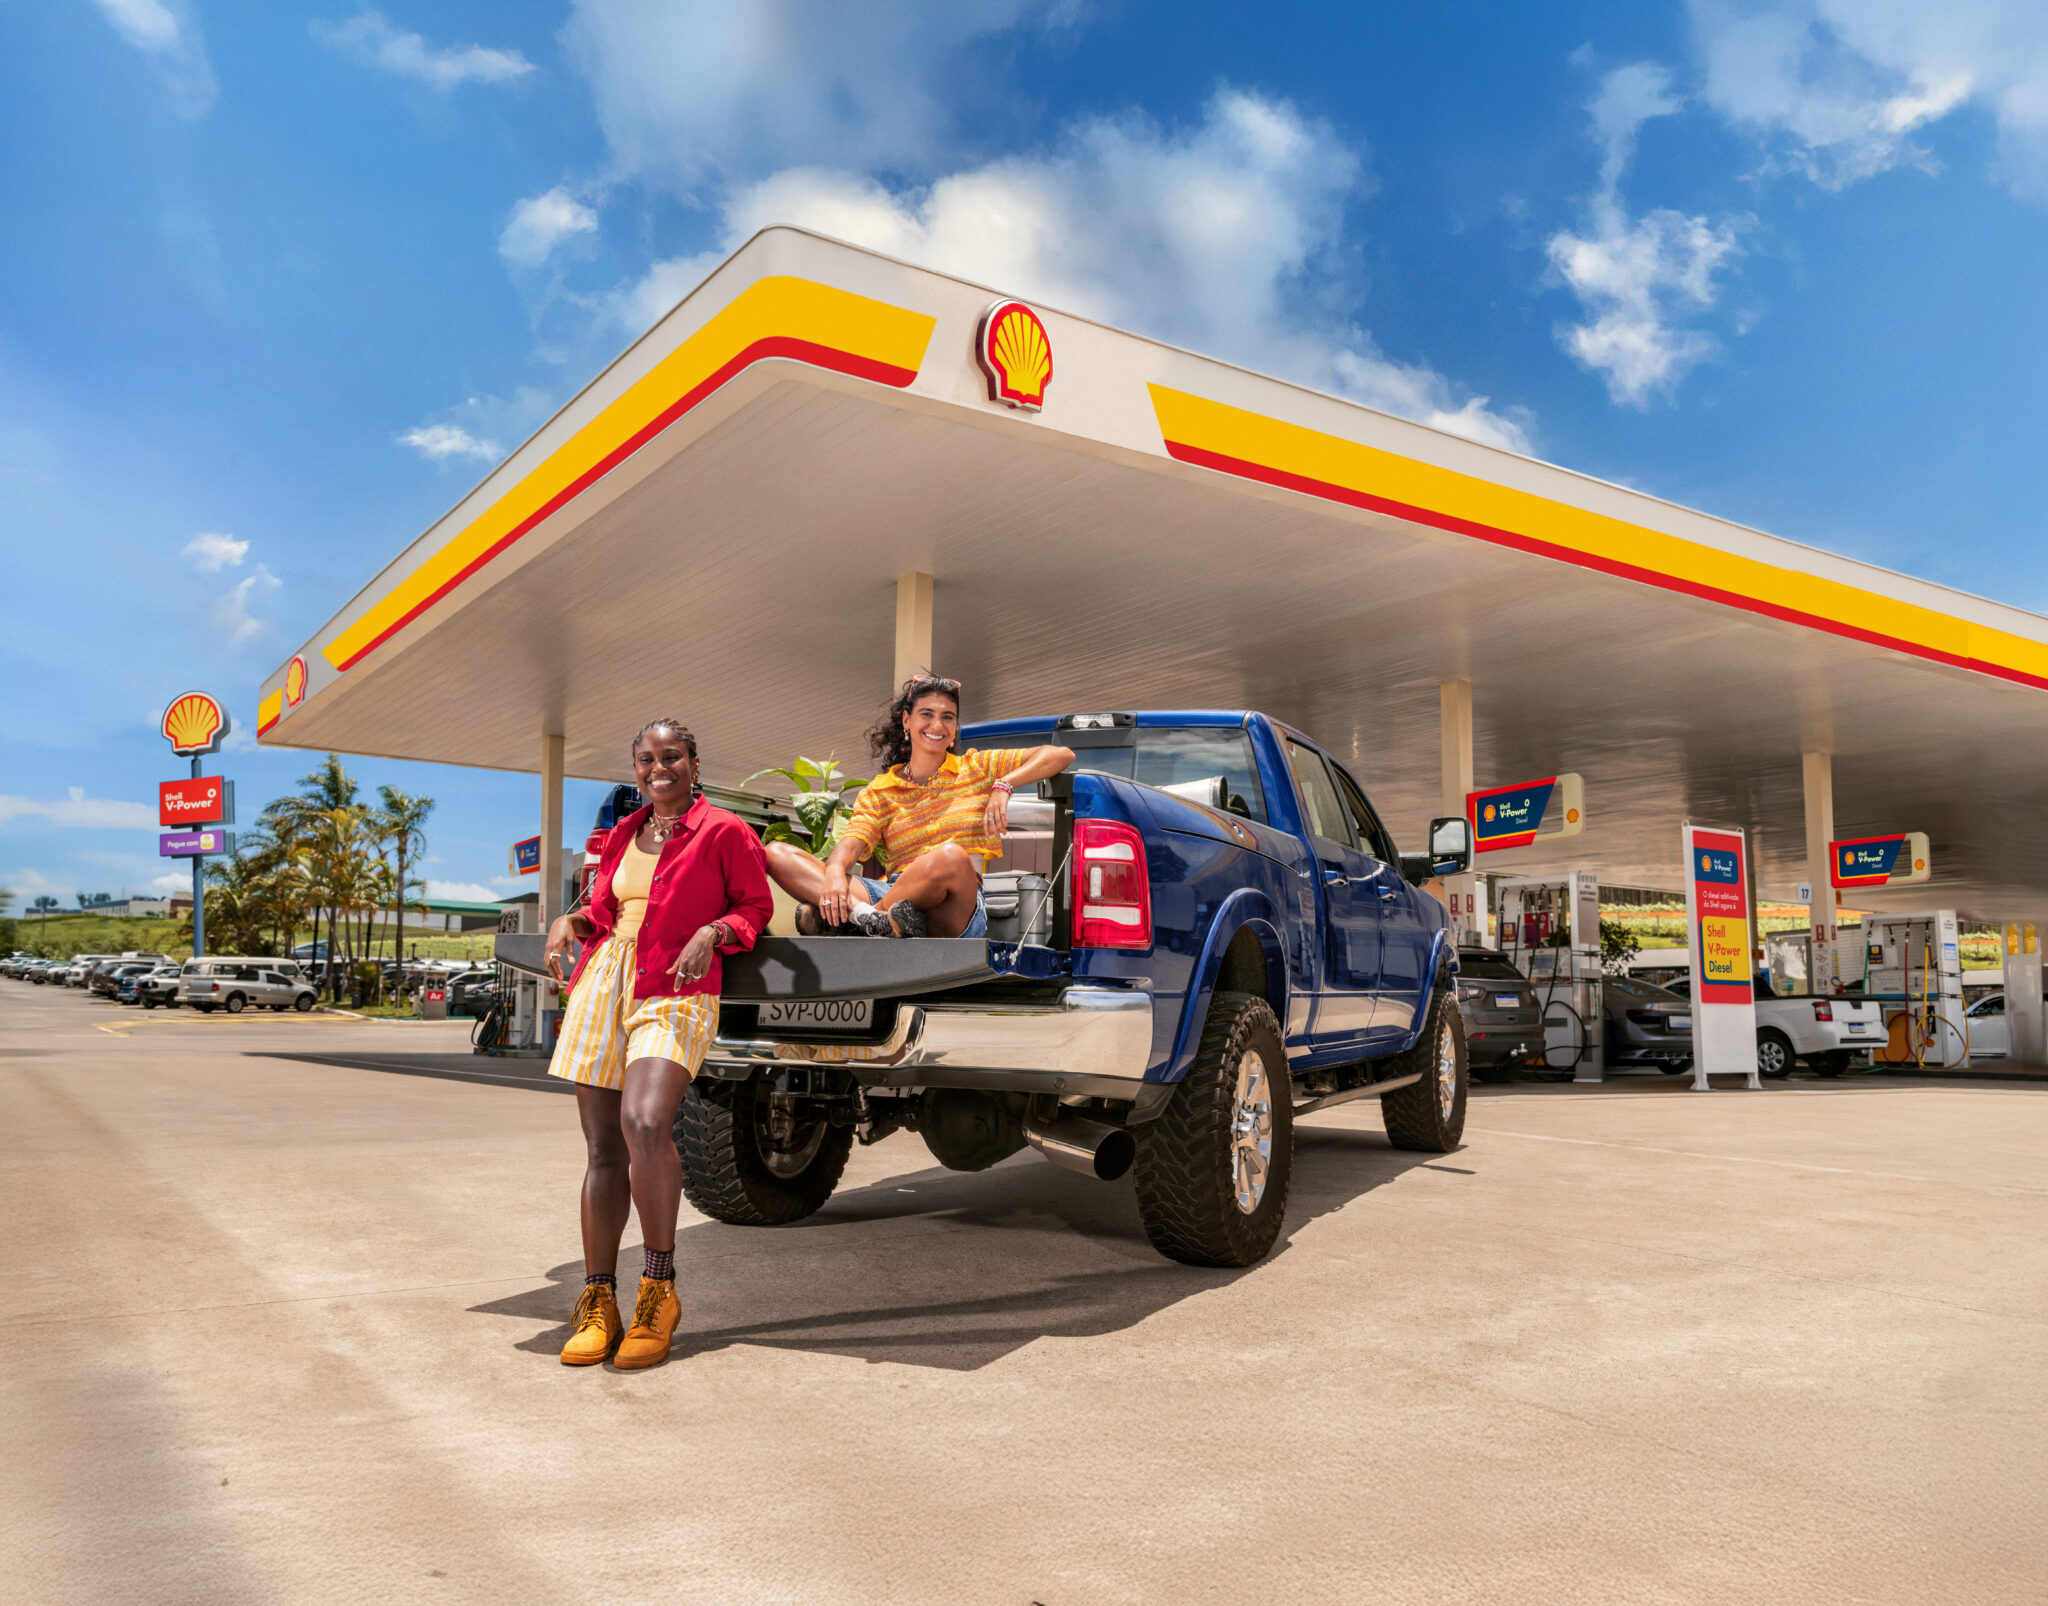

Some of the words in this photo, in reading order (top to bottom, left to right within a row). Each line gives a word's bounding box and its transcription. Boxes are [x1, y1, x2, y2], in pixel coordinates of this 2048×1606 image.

[165, 792, 183, 801] Shell
[165, 800, 213, 811] V-Power
[1500, 802, 1511, 810] Shell
[1500, 808, 1527, 818] V-Power
[1516, 817, 1528, 825] Diesel
[168, 841, 185, 849] Pague
[1703, 890, 1708, 898] O
[1801, 889, 1809, 899] 17
[1707, 924, 1726, 938] Shell
[1708, 943, 1741, 956] V-Power
[1709, 960, 1732, 973] Diesel
[430, 992, 442, 1000] Ar
[770, 1001, 866, 1021] SVP-0000
